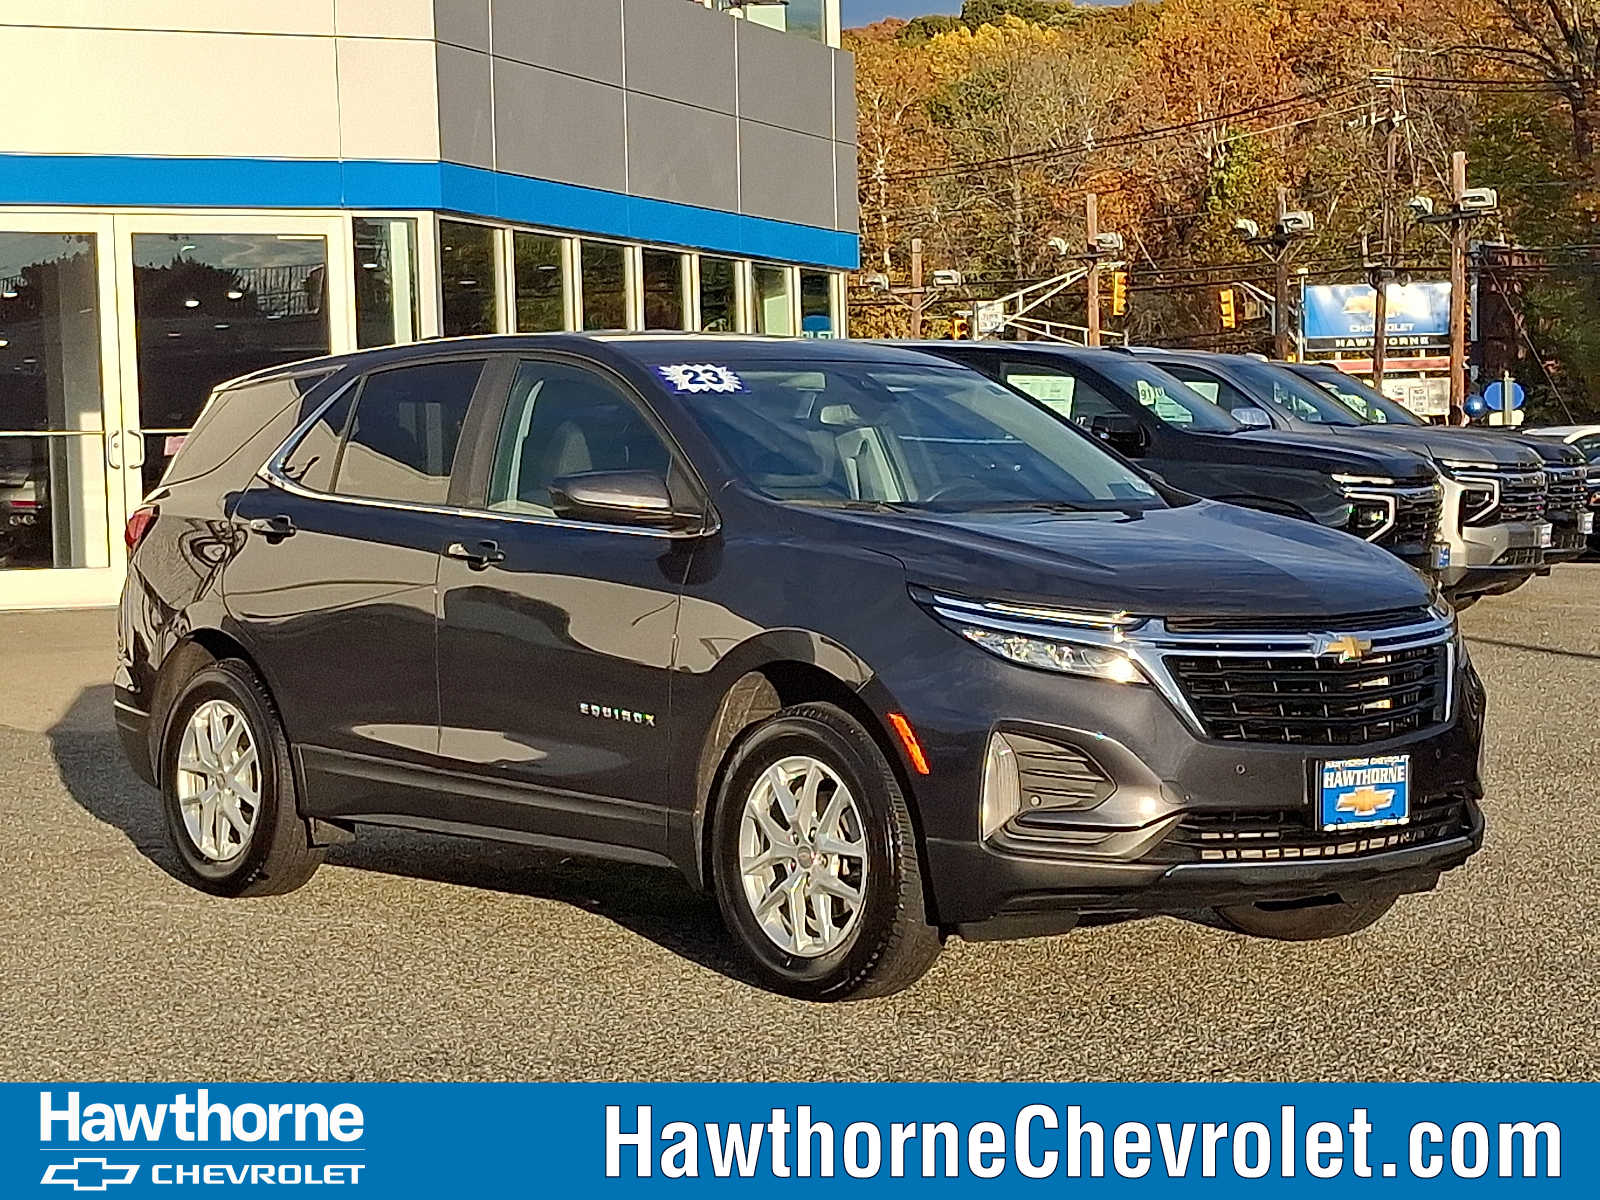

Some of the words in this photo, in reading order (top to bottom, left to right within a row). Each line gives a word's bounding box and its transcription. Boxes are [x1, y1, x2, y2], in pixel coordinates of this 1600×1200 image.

[1349, 322, 1416, 333] CHEVOLET
[682, 369, 724, 385] 23
[579, 703, 656, 727] EQUINOX
[1323, 766, 1406, 789] HAWTHORNE
